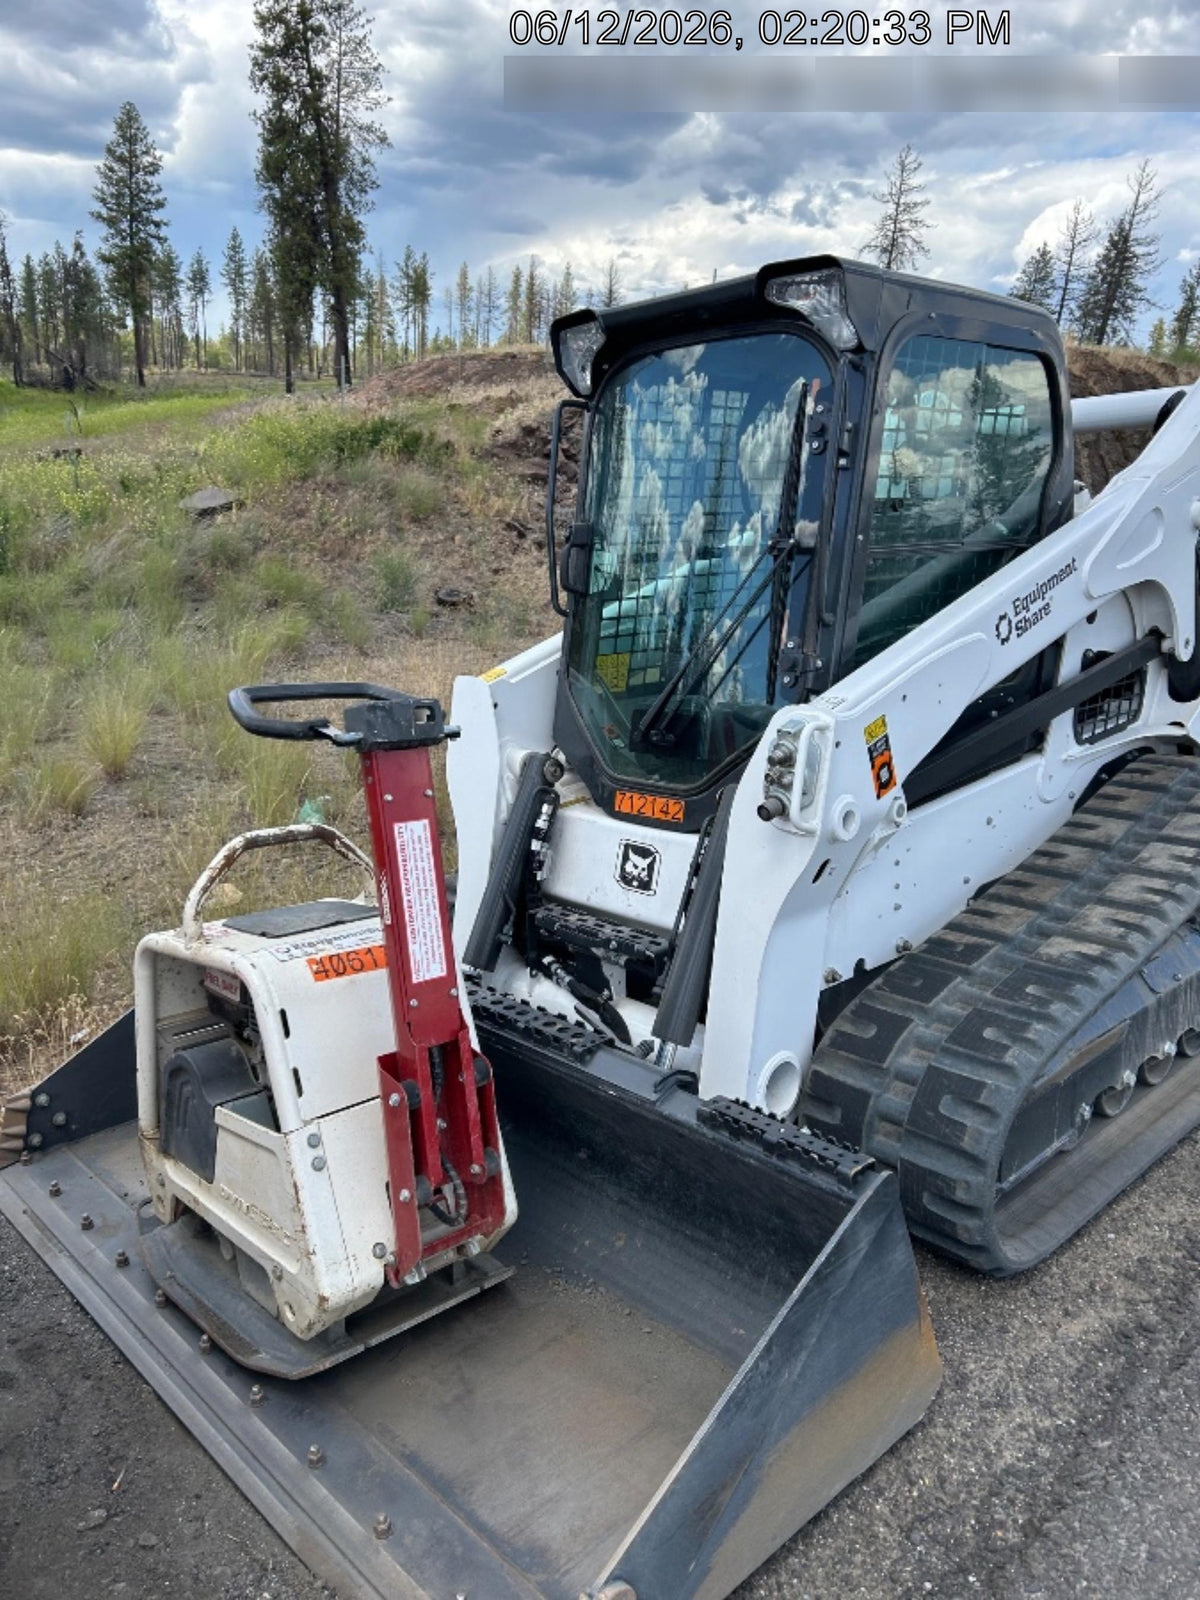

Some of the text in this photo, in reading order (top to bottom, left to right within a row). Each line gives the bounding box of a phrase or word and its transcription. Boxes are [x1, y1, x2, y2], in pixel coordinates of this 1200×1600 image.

[1012, 556, 1078, 617] Equipment
[1014, 602, 1051, 638] Share
[618, 792, 682, 821] 712142
[313, 944, 384, 979] 4061
